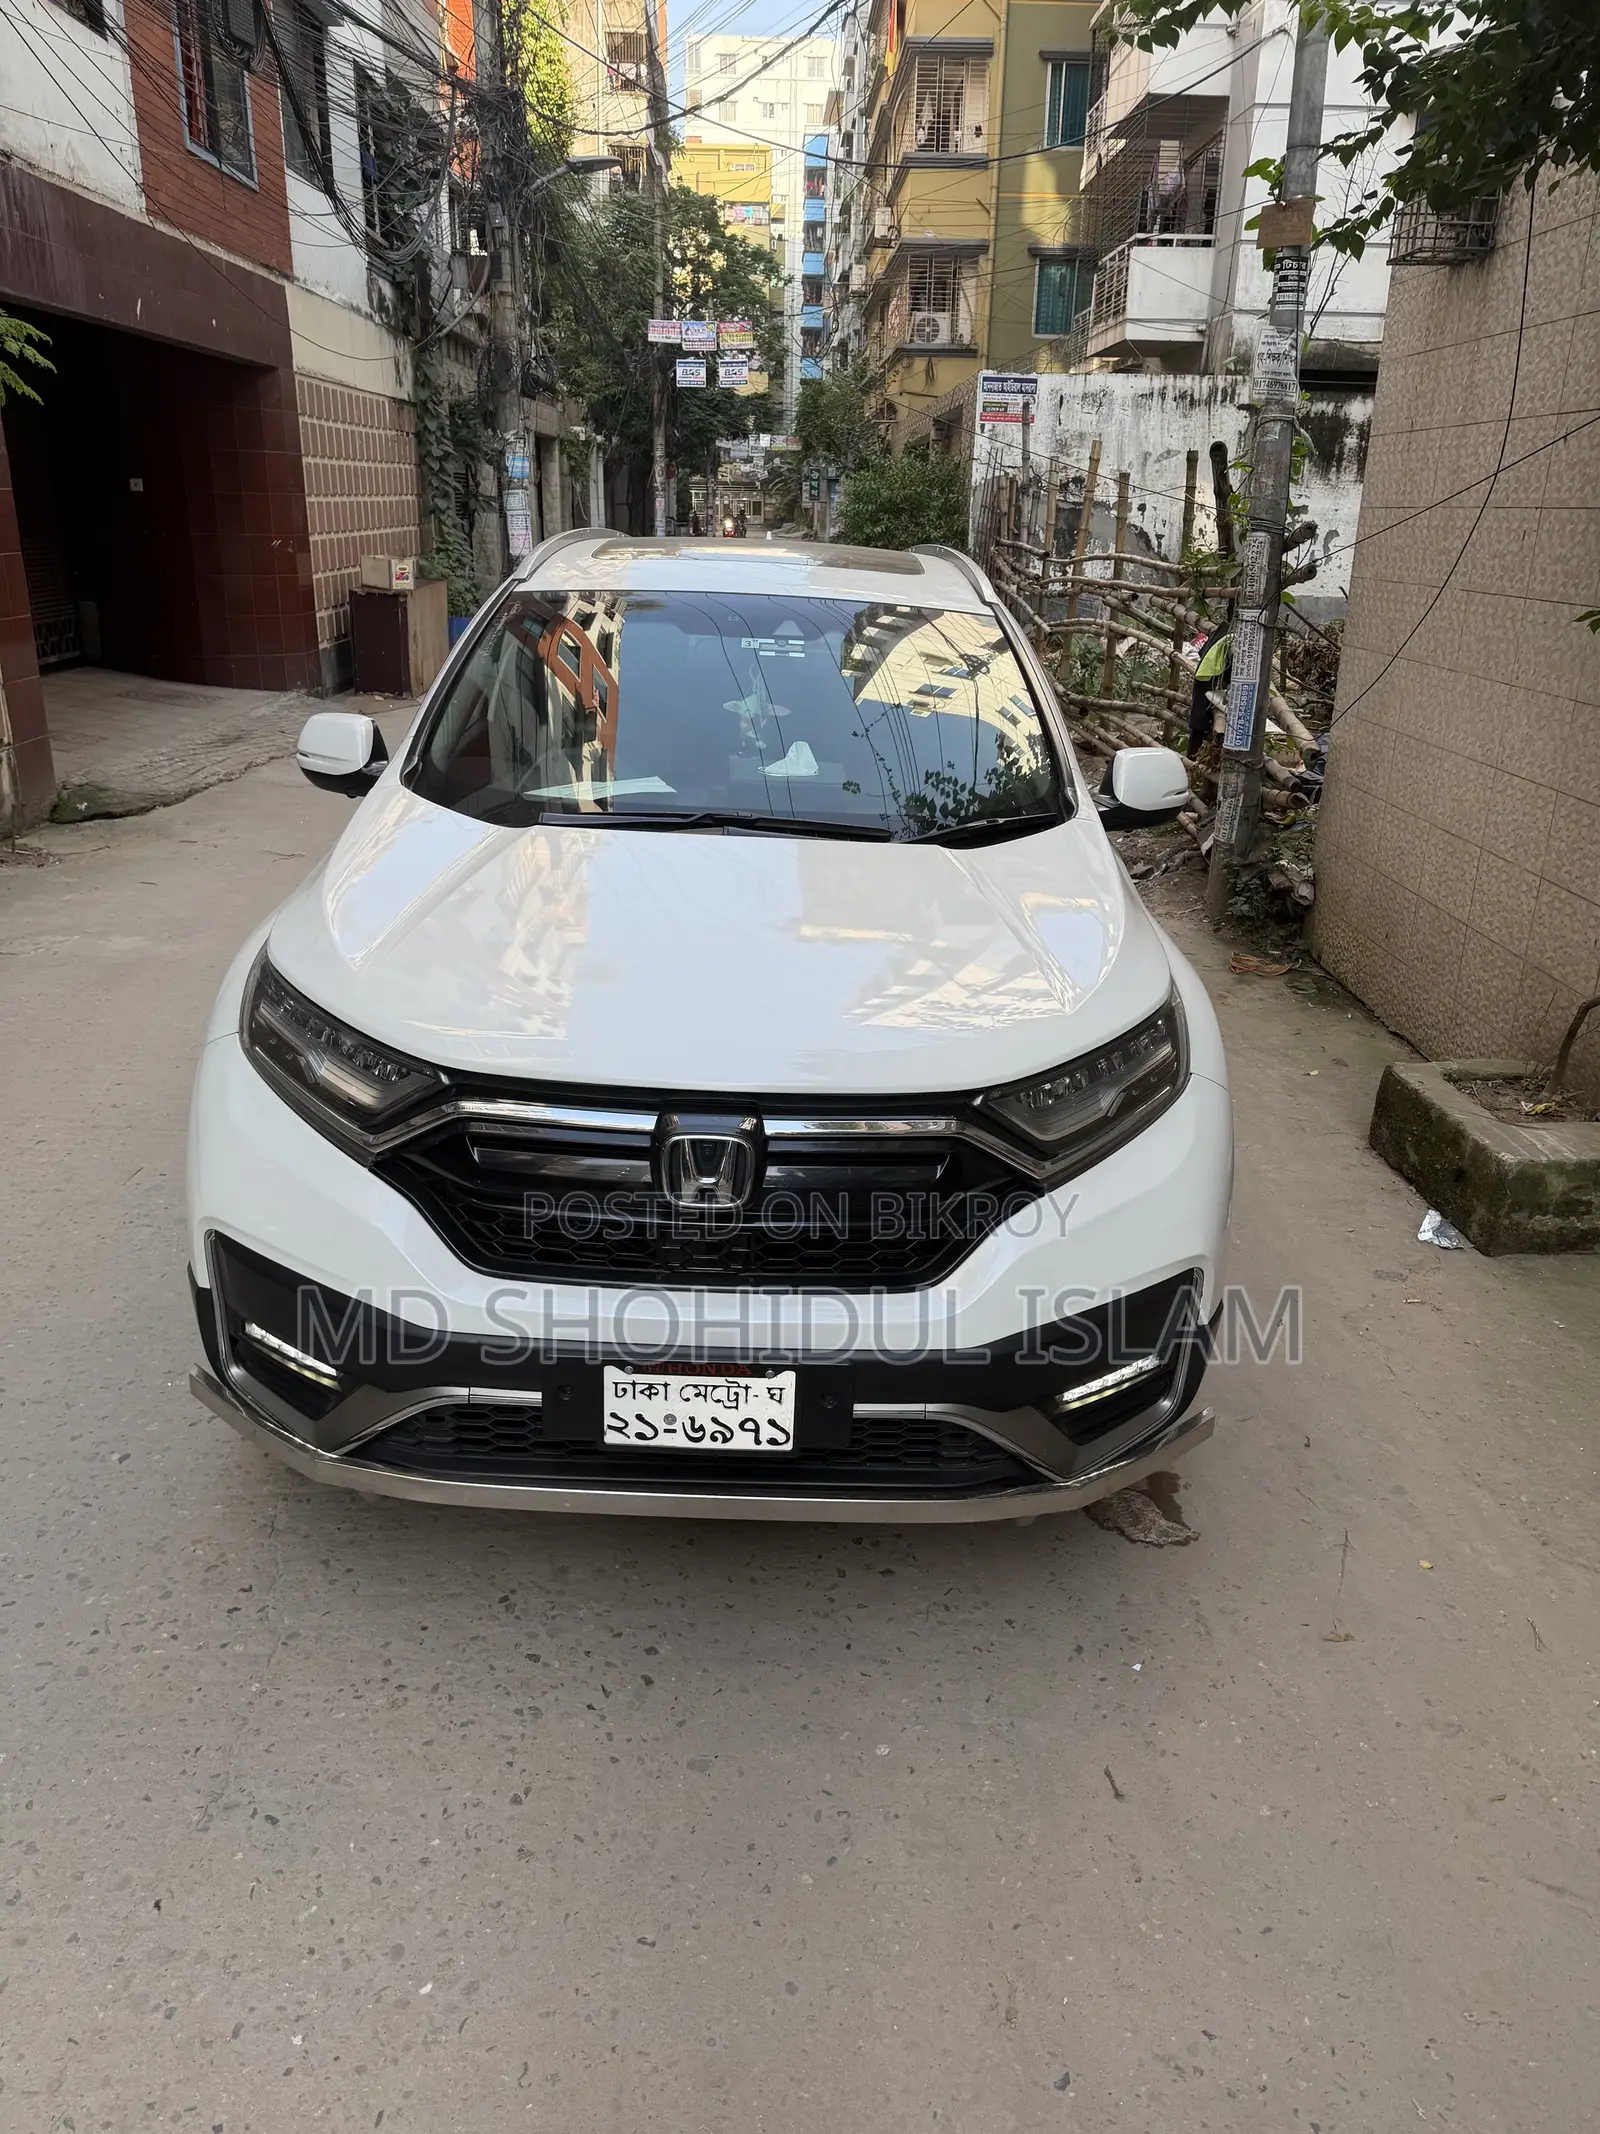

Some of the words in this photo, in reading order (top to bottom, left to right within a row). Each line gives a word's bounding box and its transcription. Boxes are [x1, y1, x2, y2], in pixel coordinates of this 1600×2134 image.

[667, 1363, 752, 1376] HONDA
[612, 1380, 671, 1401] ঢাকা
[607, 1411, 791, 1447] ২১-৬৯৭১
